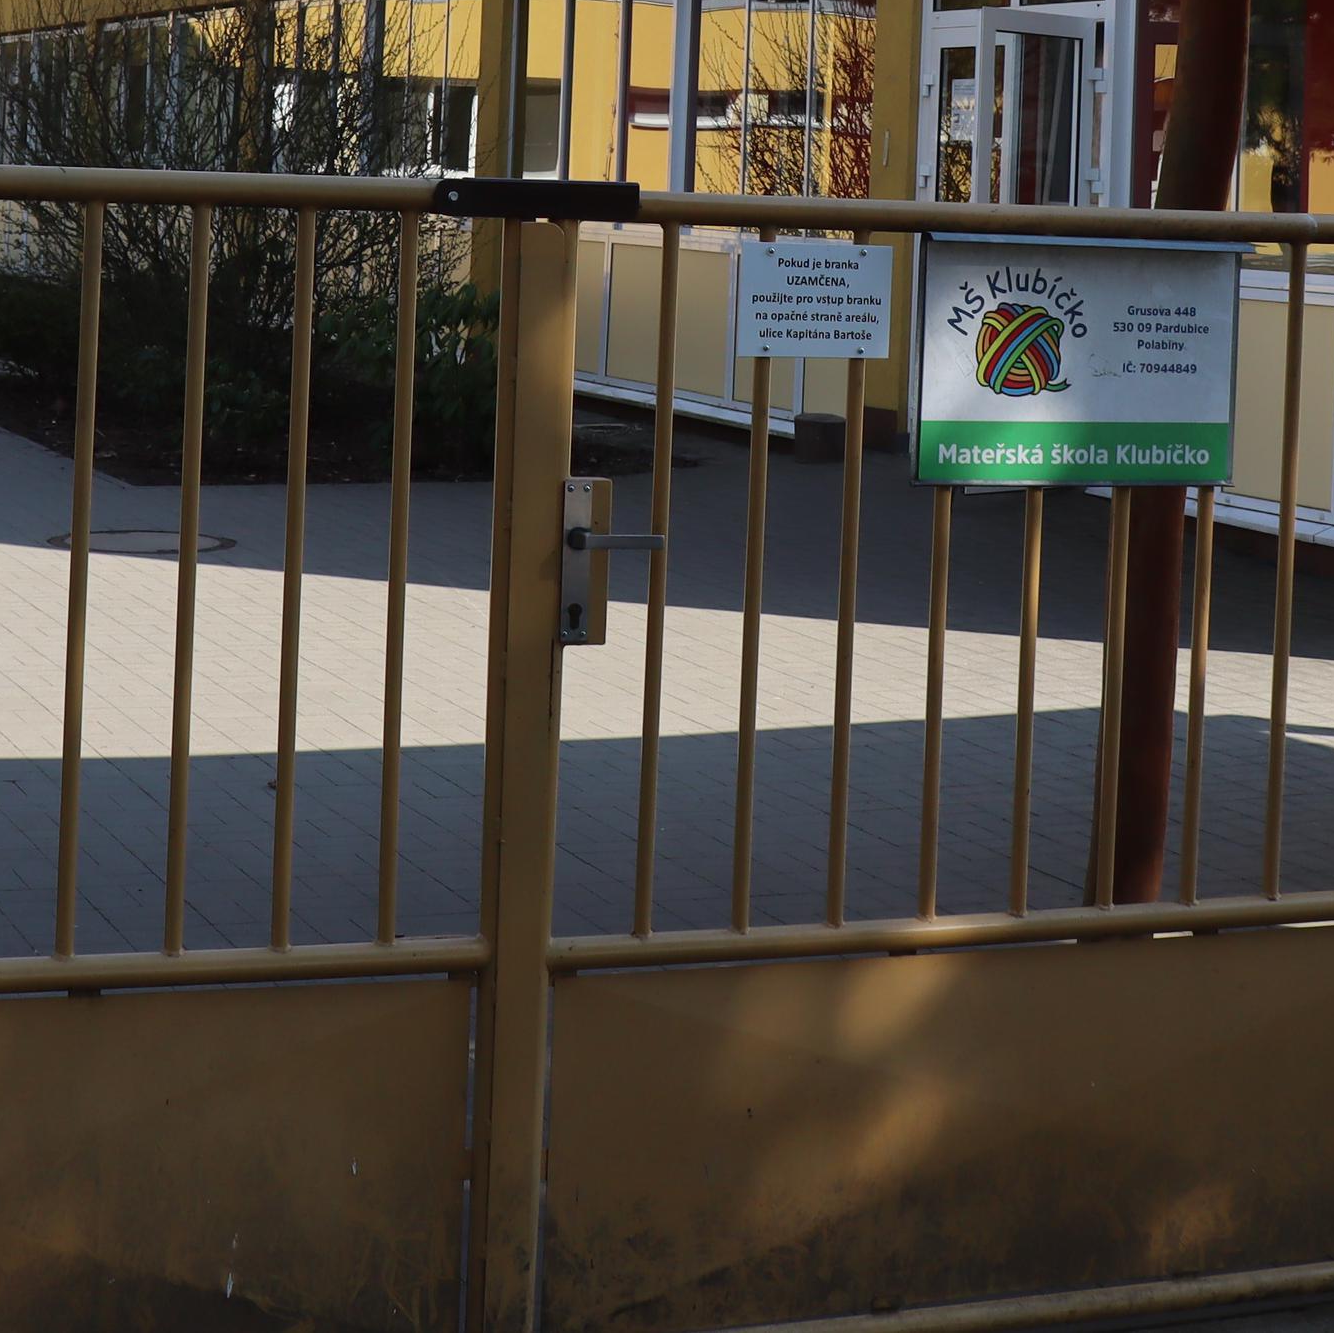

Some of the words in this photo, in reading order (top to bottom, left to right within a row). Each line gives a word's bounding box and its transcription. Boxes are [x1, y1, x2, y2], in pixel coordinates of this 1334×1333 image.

[778, 258, 810, 268] Pokud
[811, 258, 822, 270] je
[824, 259, 859, 270] branka
[786, 274, 850, 288] UZAMČENA,
[752, 292, 793, 305] použijte
[796, 295, 814, 305] pro
[816, 295, 844, 306] vstup
[846, 294, 882, 306] branku
[947, 281, 985, 336] MŠ
[986, 267, 1088, 338] Klubíčko
[755, 312, 768, 320] na
[771, 310, 808, 322] opačné
[810, 311, 843, 322] straně
[845, 312, 879, 325] areálu,
[1127, 305, 1171, 317] Grusova
[1174, 306, 1197, 317] 448
[759, 328, 783, 338] ulice
[786, 328, 831, 341] Kapitána
[833, 329, 872, 340] Bartoše
[1113, 322, 1134, 332] 530
[1137, 322, 1152, 333] 09
[1155, 323, 1210, 334] Pardubice
[1137, 339, 1184, 351] Polabiny
[1122, 361, 1136, 373] IČ:
[1139, 363, 1197, 374] 70944849
[938, 443, 1044, 465] Mateřská
[1050, 443, 1108, 465] škola
[1116, 443, 1210, 465] Klubíčko
